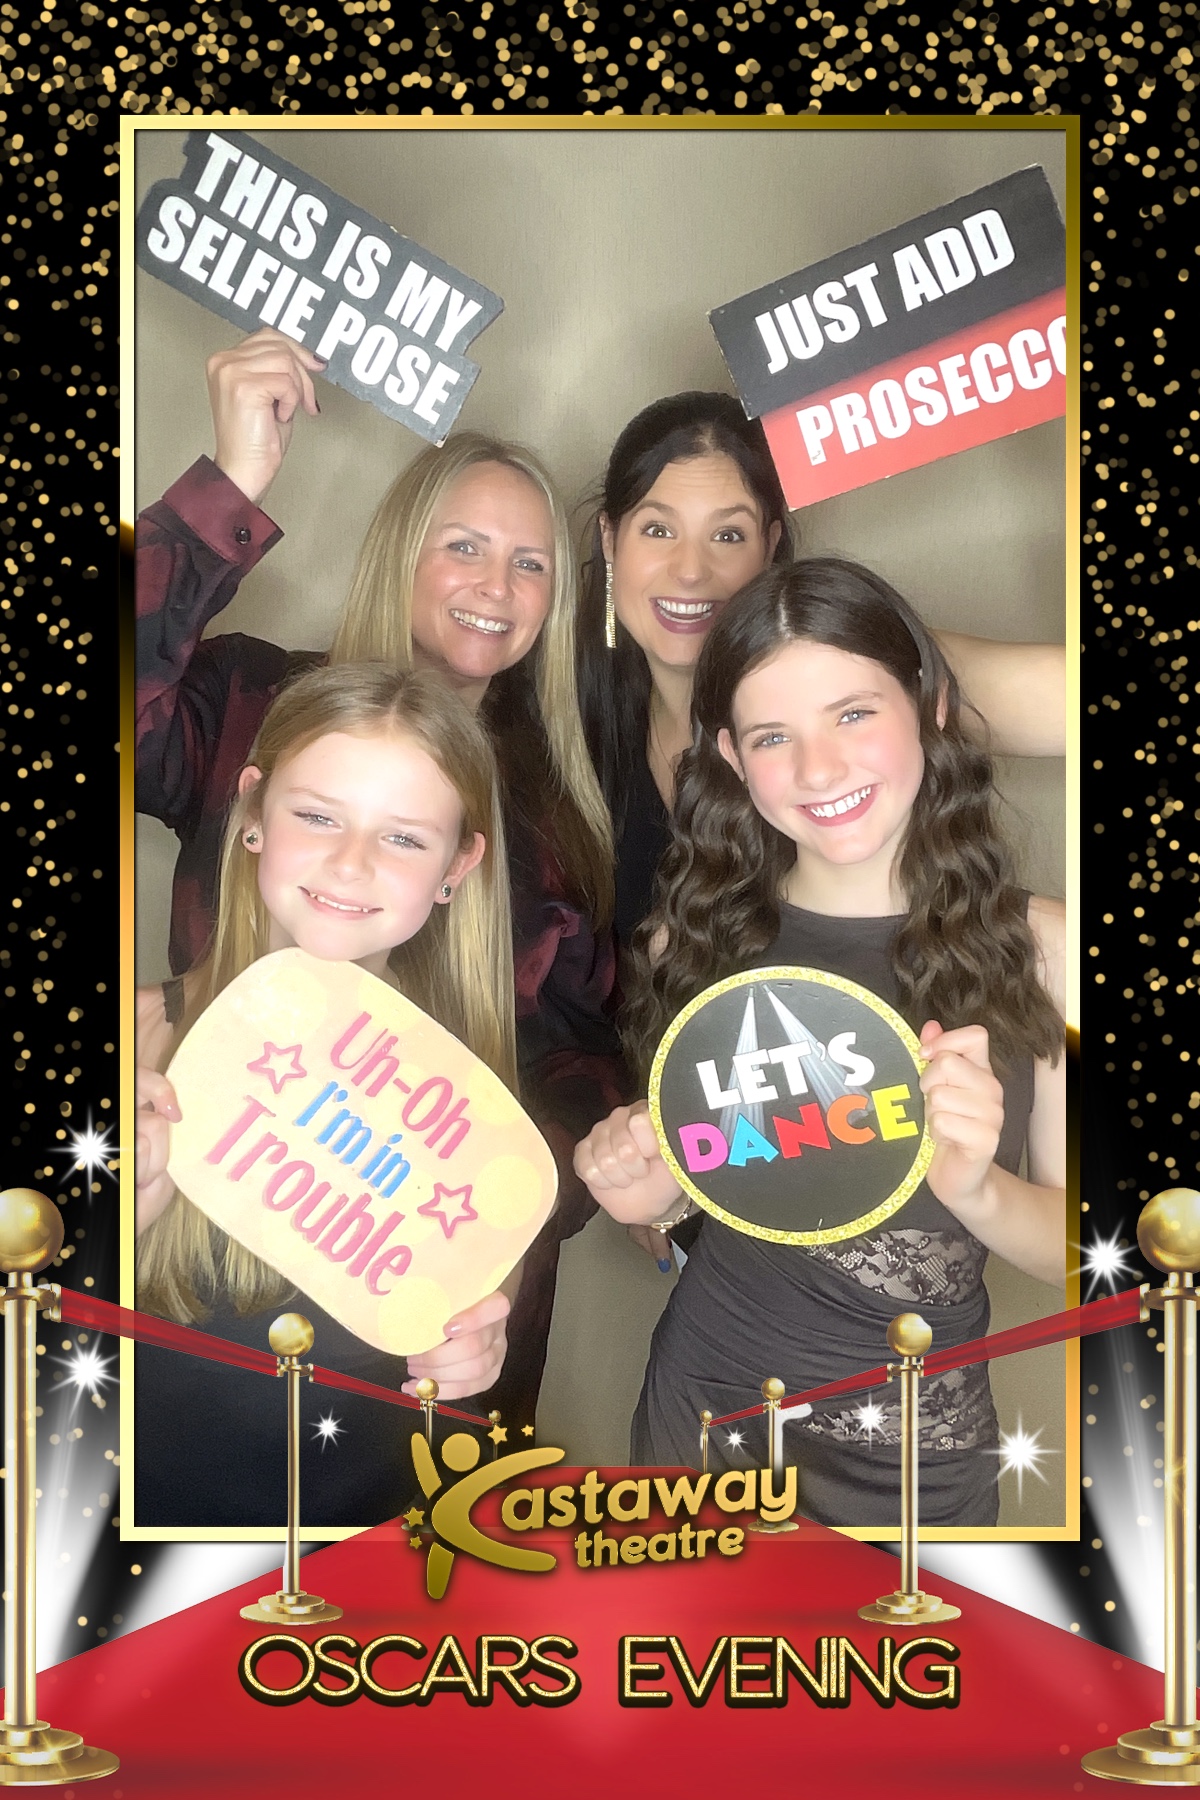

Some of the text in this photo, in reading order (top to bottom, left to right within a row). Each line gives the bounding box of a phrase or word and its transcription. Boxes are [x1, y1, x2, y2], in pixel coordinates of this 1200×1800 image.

[147, 195, 460, 425] SELFIE POSE
[194, 132, 483, 353] THIS IS MY
[754, 208, 1016, 375] JUST ADD
[330, 1011, 471, 1160] Uh-Oh
[678, 1083, 919, 1172] DANCE
[204, 1095, 413, 1296] Trouble
